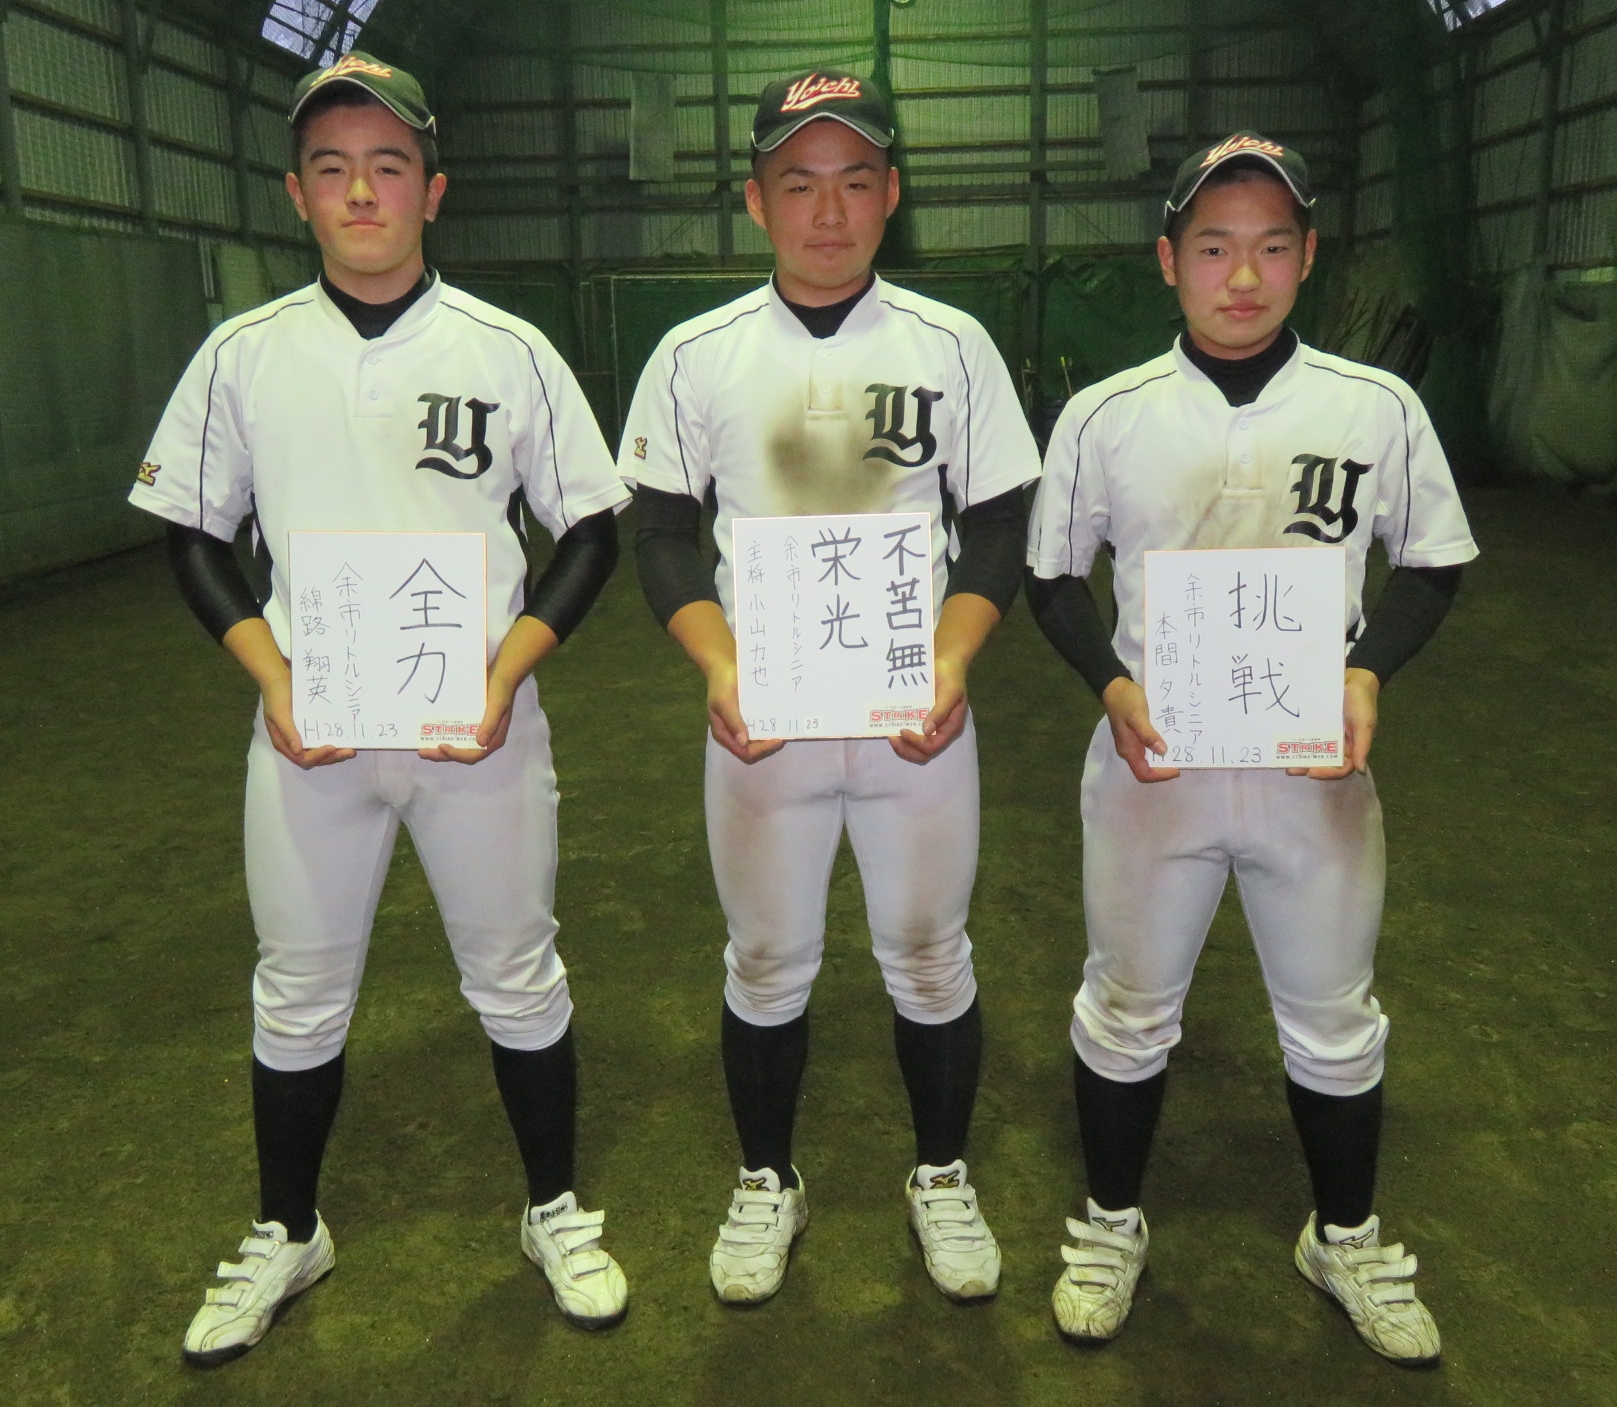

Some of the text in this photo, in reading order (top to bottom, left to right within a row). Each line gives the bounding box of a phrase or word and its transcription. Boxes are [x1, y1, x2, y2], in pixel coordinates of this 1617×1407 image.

[779, 73, 862, 112] Yoichi
[811, 526, 869, 650] 栄光
[882, 524, 928, 689] 不苦無
[388, 557, 468, 704] 全力
[1228, 571, 1303, 718] 挑戦
[420, 723, 481, 736] STRIKE
[869, 708, 929, 722] STRIKE
[1276, 740, 1339, 754] STRIKE
